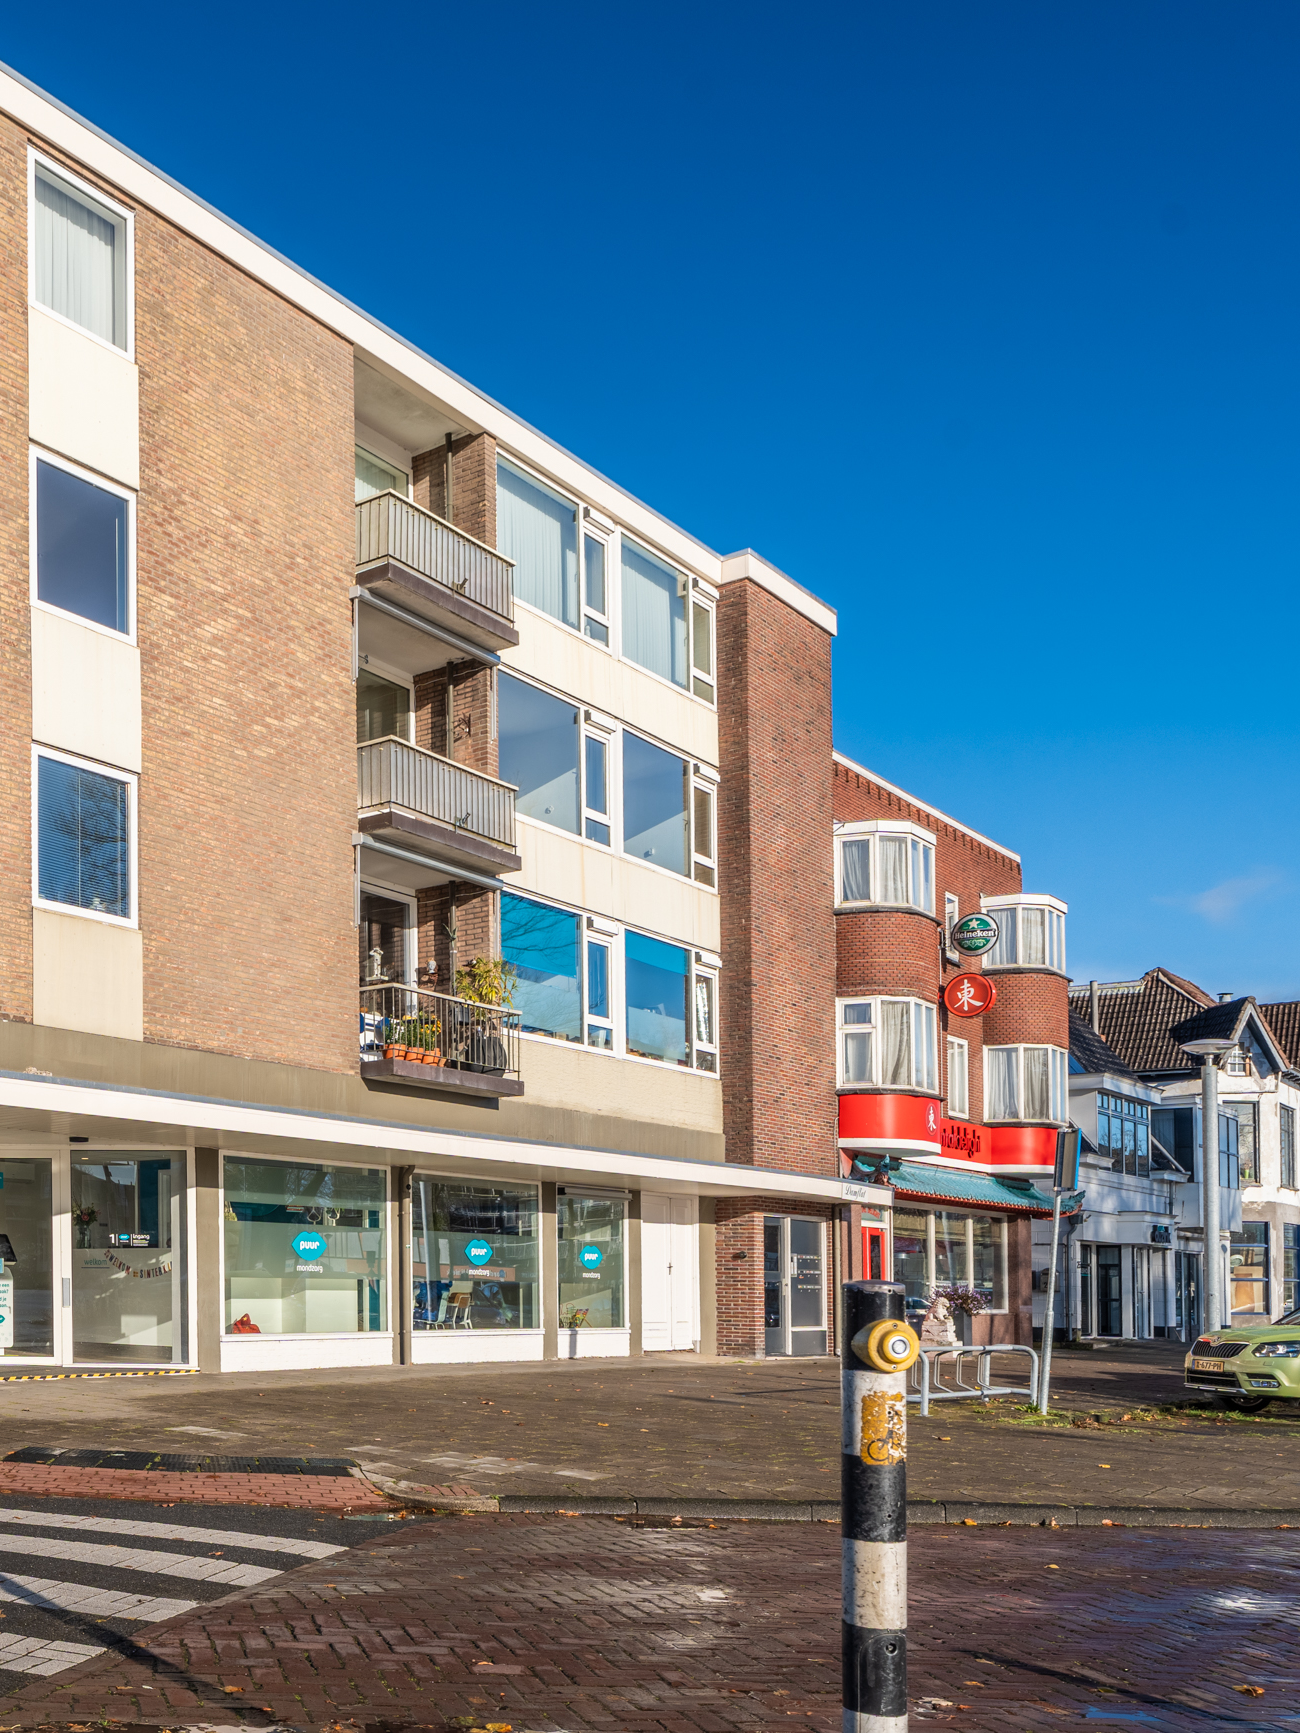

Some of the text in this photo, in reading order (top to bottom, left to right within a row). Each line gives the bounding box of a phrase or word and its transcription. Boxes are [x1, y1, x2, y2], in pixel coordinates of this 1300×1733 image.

[955, 929, 995, 940] Heineken
[954, 979, 984, 1011] 東
[109, 1234, 115, 1244] 1
[299, 1240, 320, 1251] puur
[470, 1247, 488, 1257] puur
[584, 1252, 599, 1262] puur
[83, 1258, 108, 1266] welkom
[296, 1264, 324, 1274] mondzorg
[468, 1268, 490, 1277] mondzorg
